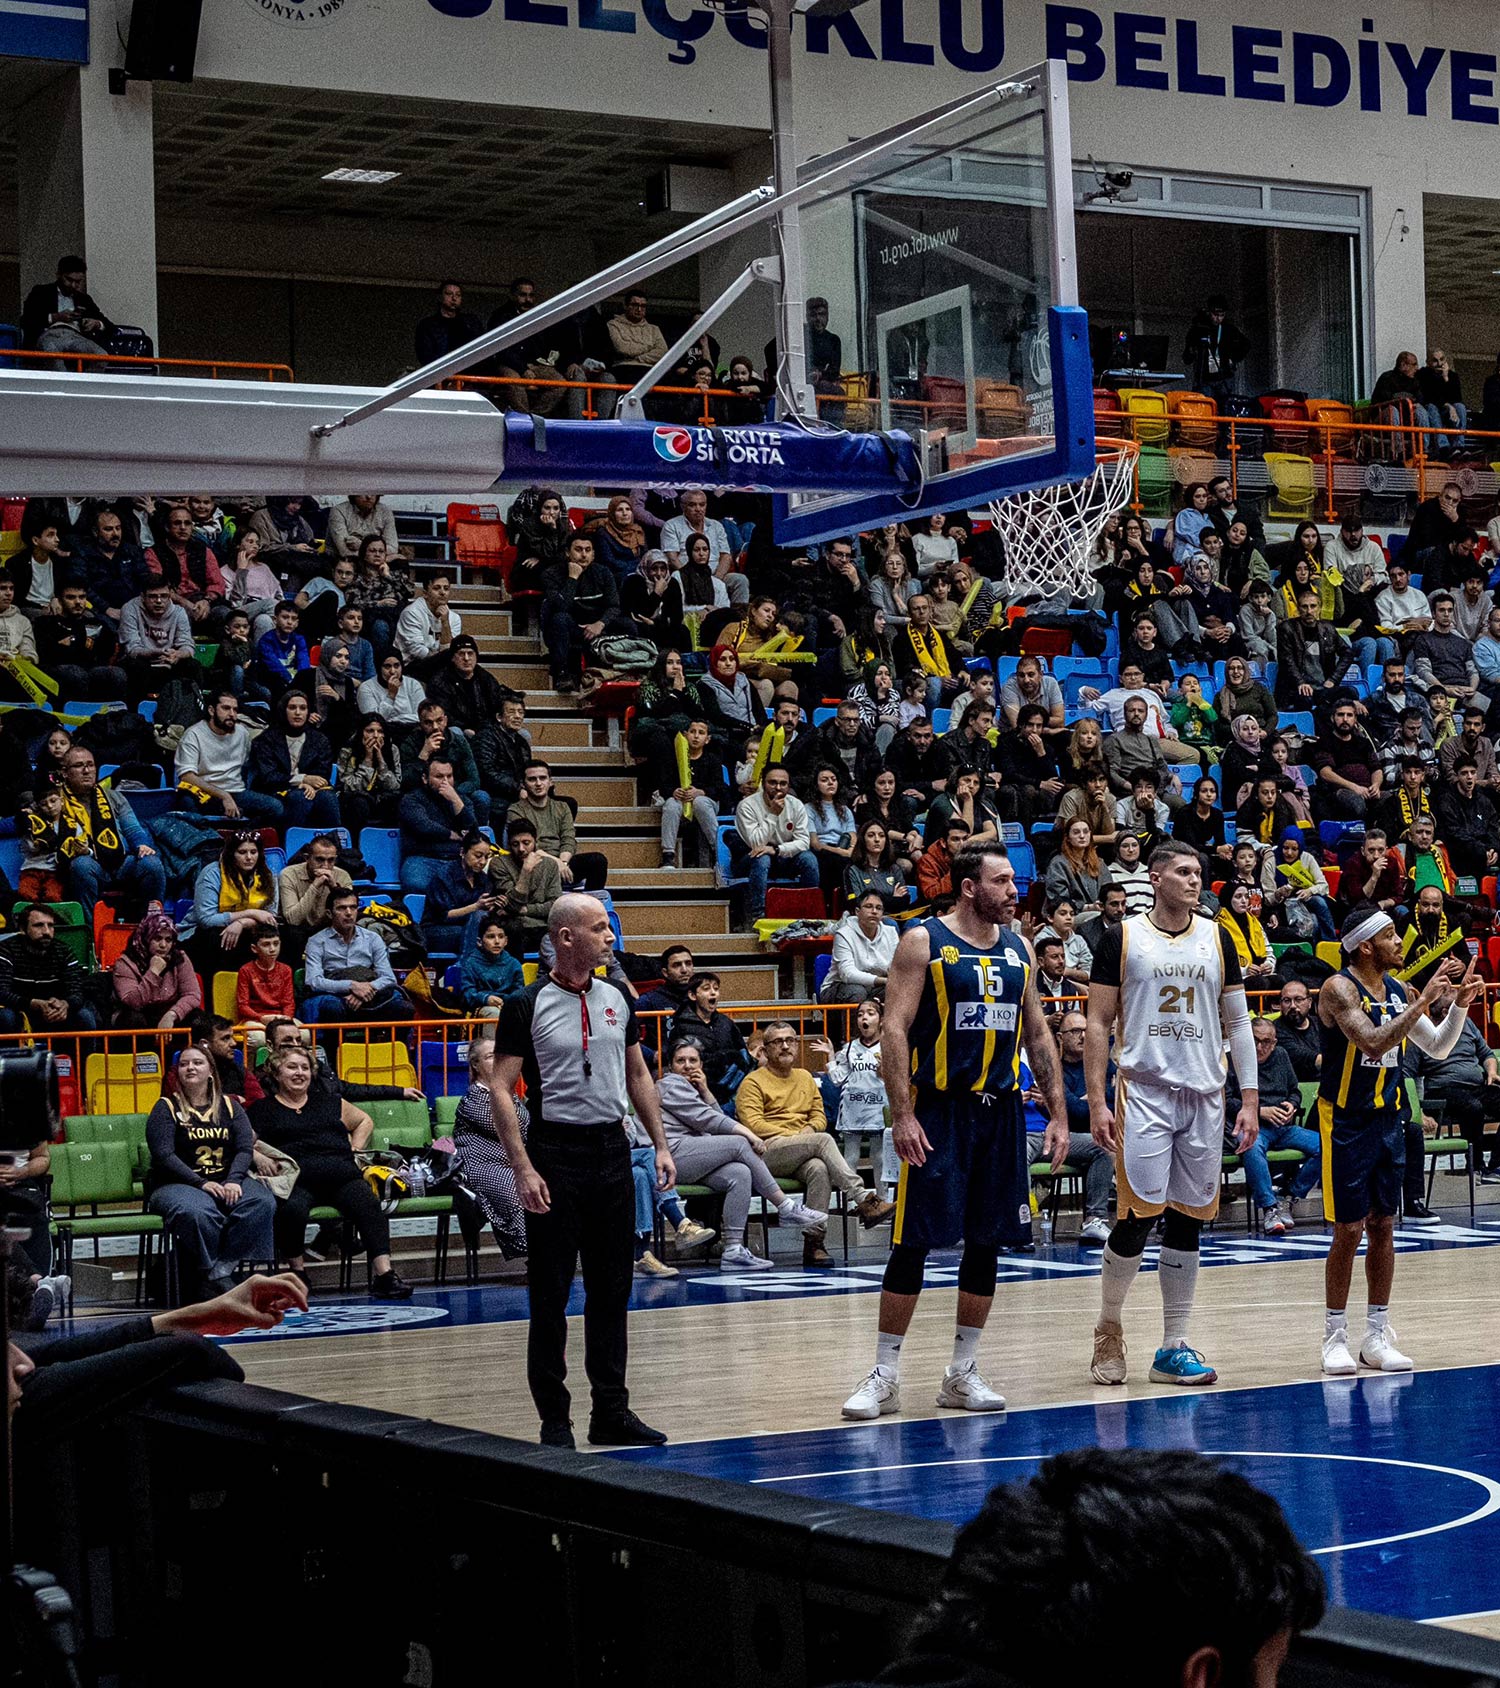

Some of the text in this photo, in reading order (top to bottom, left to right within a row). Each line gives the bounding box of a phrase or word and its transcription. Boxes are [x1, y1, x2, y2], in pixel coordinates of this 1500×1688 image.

[255, 0, 305, 20] ONYA
[973, 965, 1003, 997] 15
[1153, 963, 1205, 982] KONYA
[1158, 985, 1195, 1013] 21
[188, 1128, 229, 1140] KONYA
[195, 1146, 224, 1166] 21
